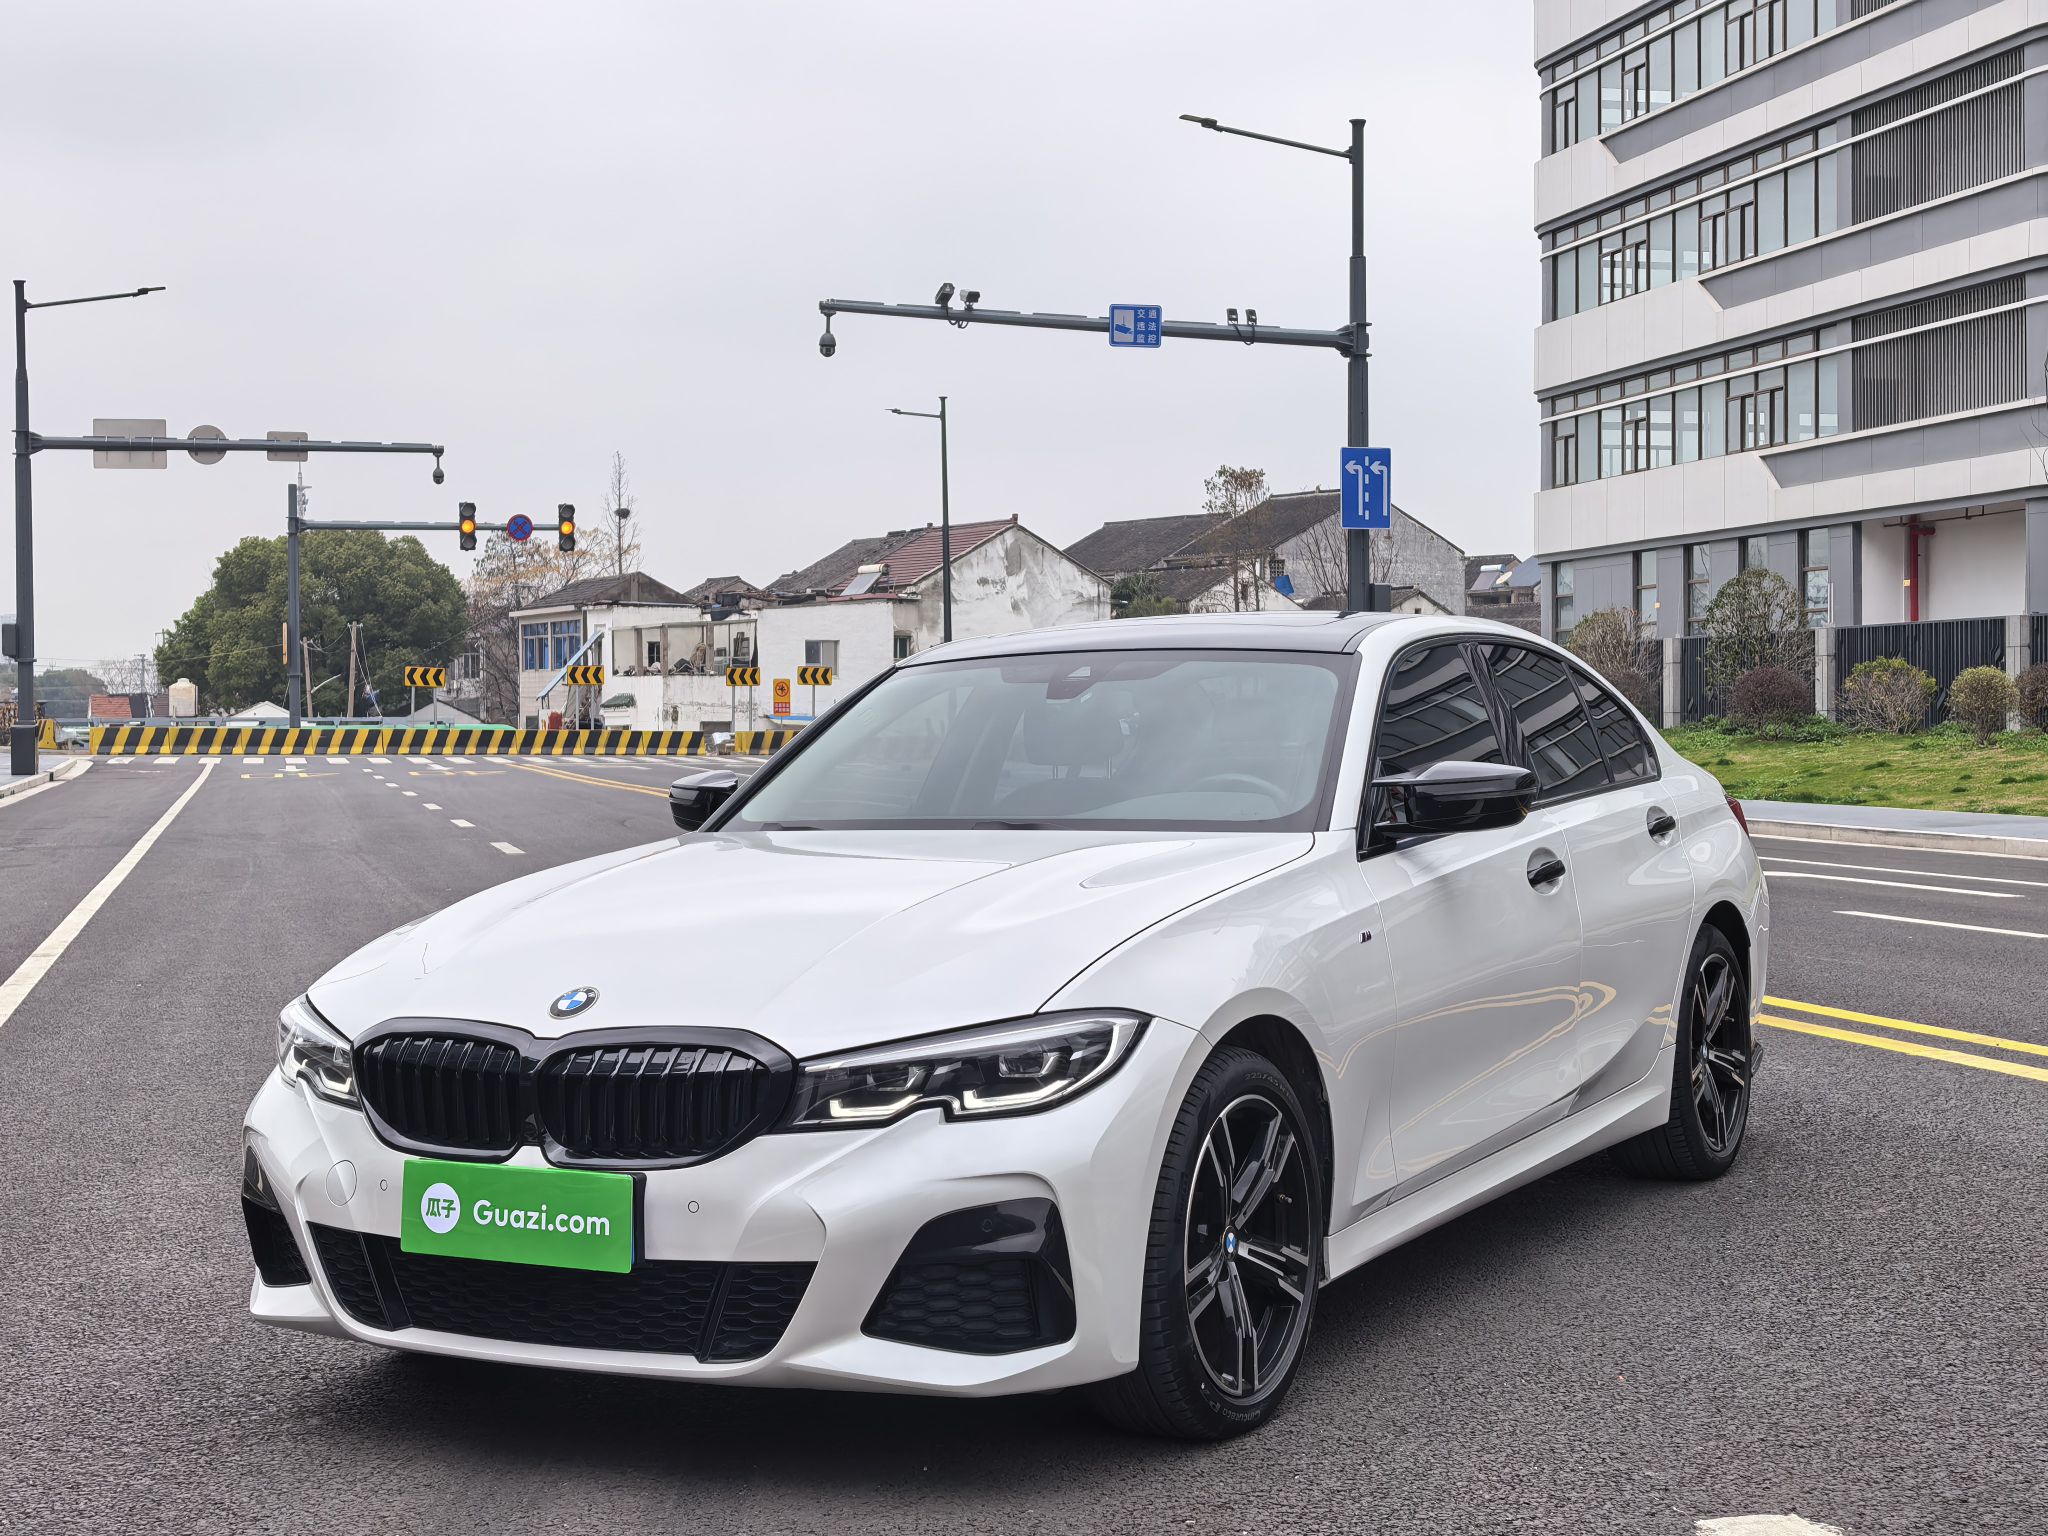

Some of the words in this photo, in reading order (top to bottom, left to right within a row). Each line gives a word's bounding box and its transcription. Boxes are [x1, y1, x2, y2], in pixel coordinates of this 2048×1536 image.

[1137, 309, 1157, 319] 交通
[1137, 321, 1157, 331] 违法
[1136, 333, 1156, 343] 监控
[426, 1197, 456, 1218] 瓜子
[473, 1199, 610, 1236] Guazi.com
